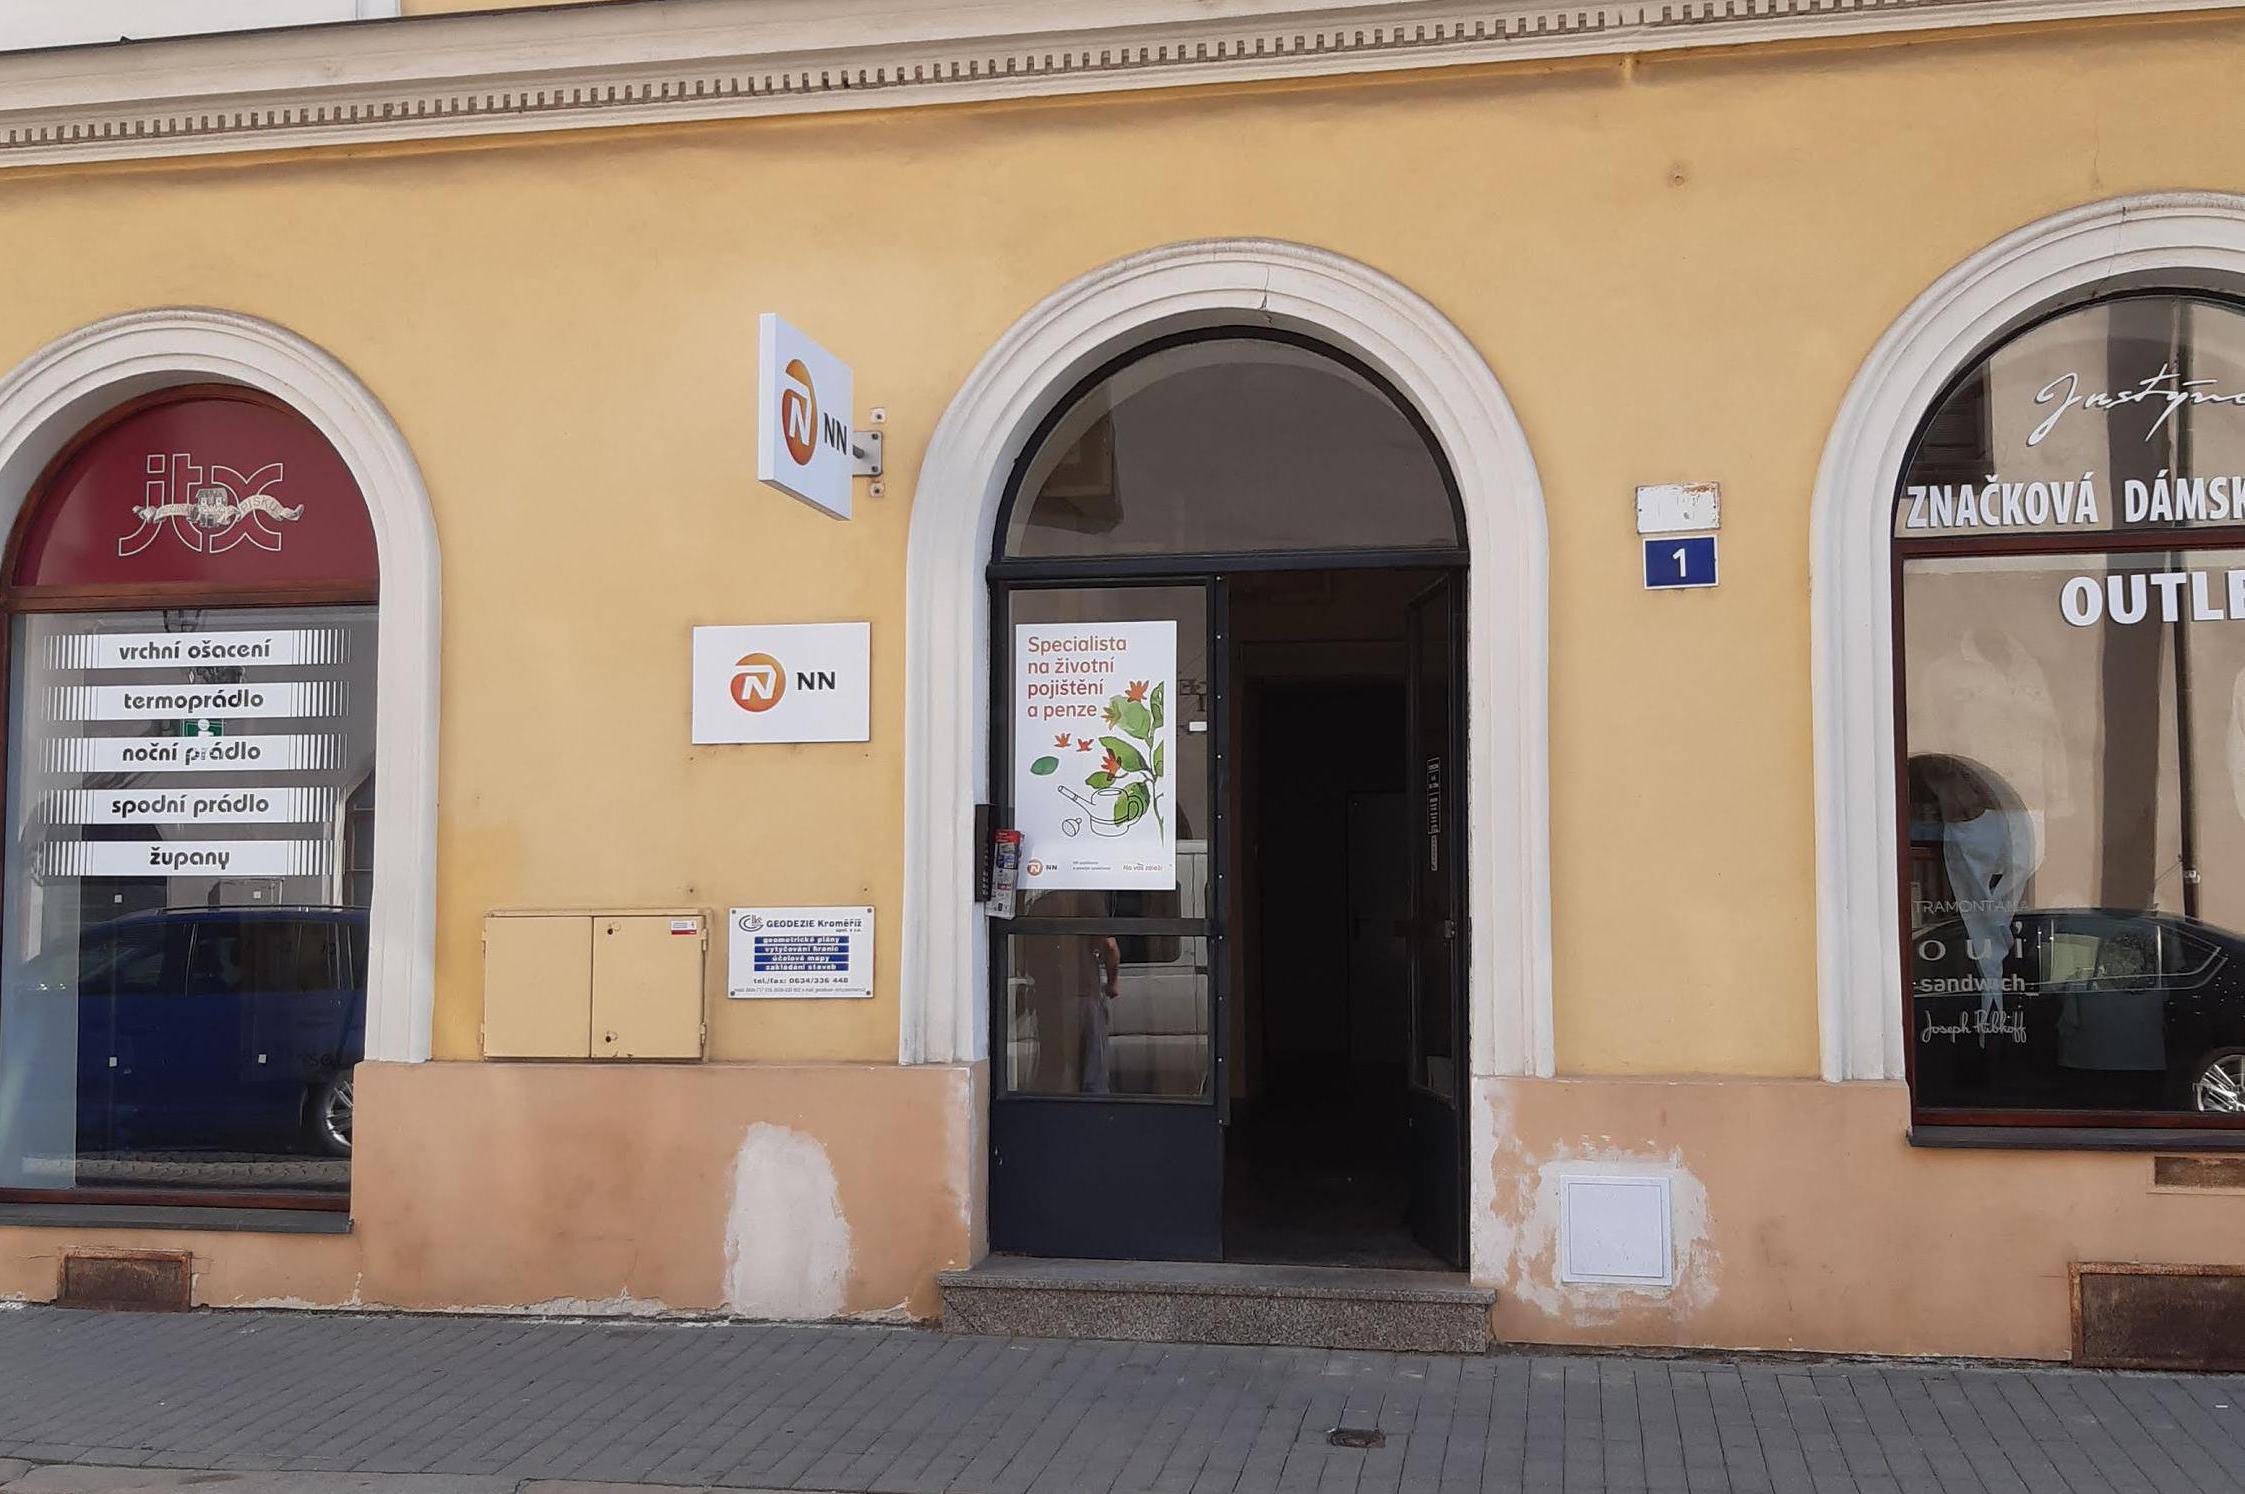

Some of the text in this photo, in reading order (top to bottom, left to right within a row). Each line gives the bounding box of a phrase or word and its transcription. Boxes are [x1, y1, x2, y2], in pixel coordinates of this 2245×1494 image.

[824, 412, 847, 455] NN
[1906, 471, 2099, 529] ZNAČKOVÁ
[1672, 548, 1687, 578] 1
[119, 638, 272, 660] vrchní ošacení
[1027, 636, 1127, 656] Specialista
[1027, 656, 1114, 674] na životní
[796, 671, 836, 690] NN
[1027, 678, 1104, 700] pojištění
[124, 690, 264, 713] termoprádlo
[1027, 704, 1097, 721] a penze
[122, 741, 261, 766] noční prádlo
[112, 794, 269, 819] spodní prádlo
[150, 846, 230, 870] župany
[766, 919, 816, 928] GEODEZIE
[817, 917, 862, 928] Kroměříž
[763, 935, 841, 944] geometrické plány
[807, 955, 831, 963] mapy
[1920, 973, 2026, 992] sandwch
[1921, 1009, 2027, 1050] Joseph Ribkoff
